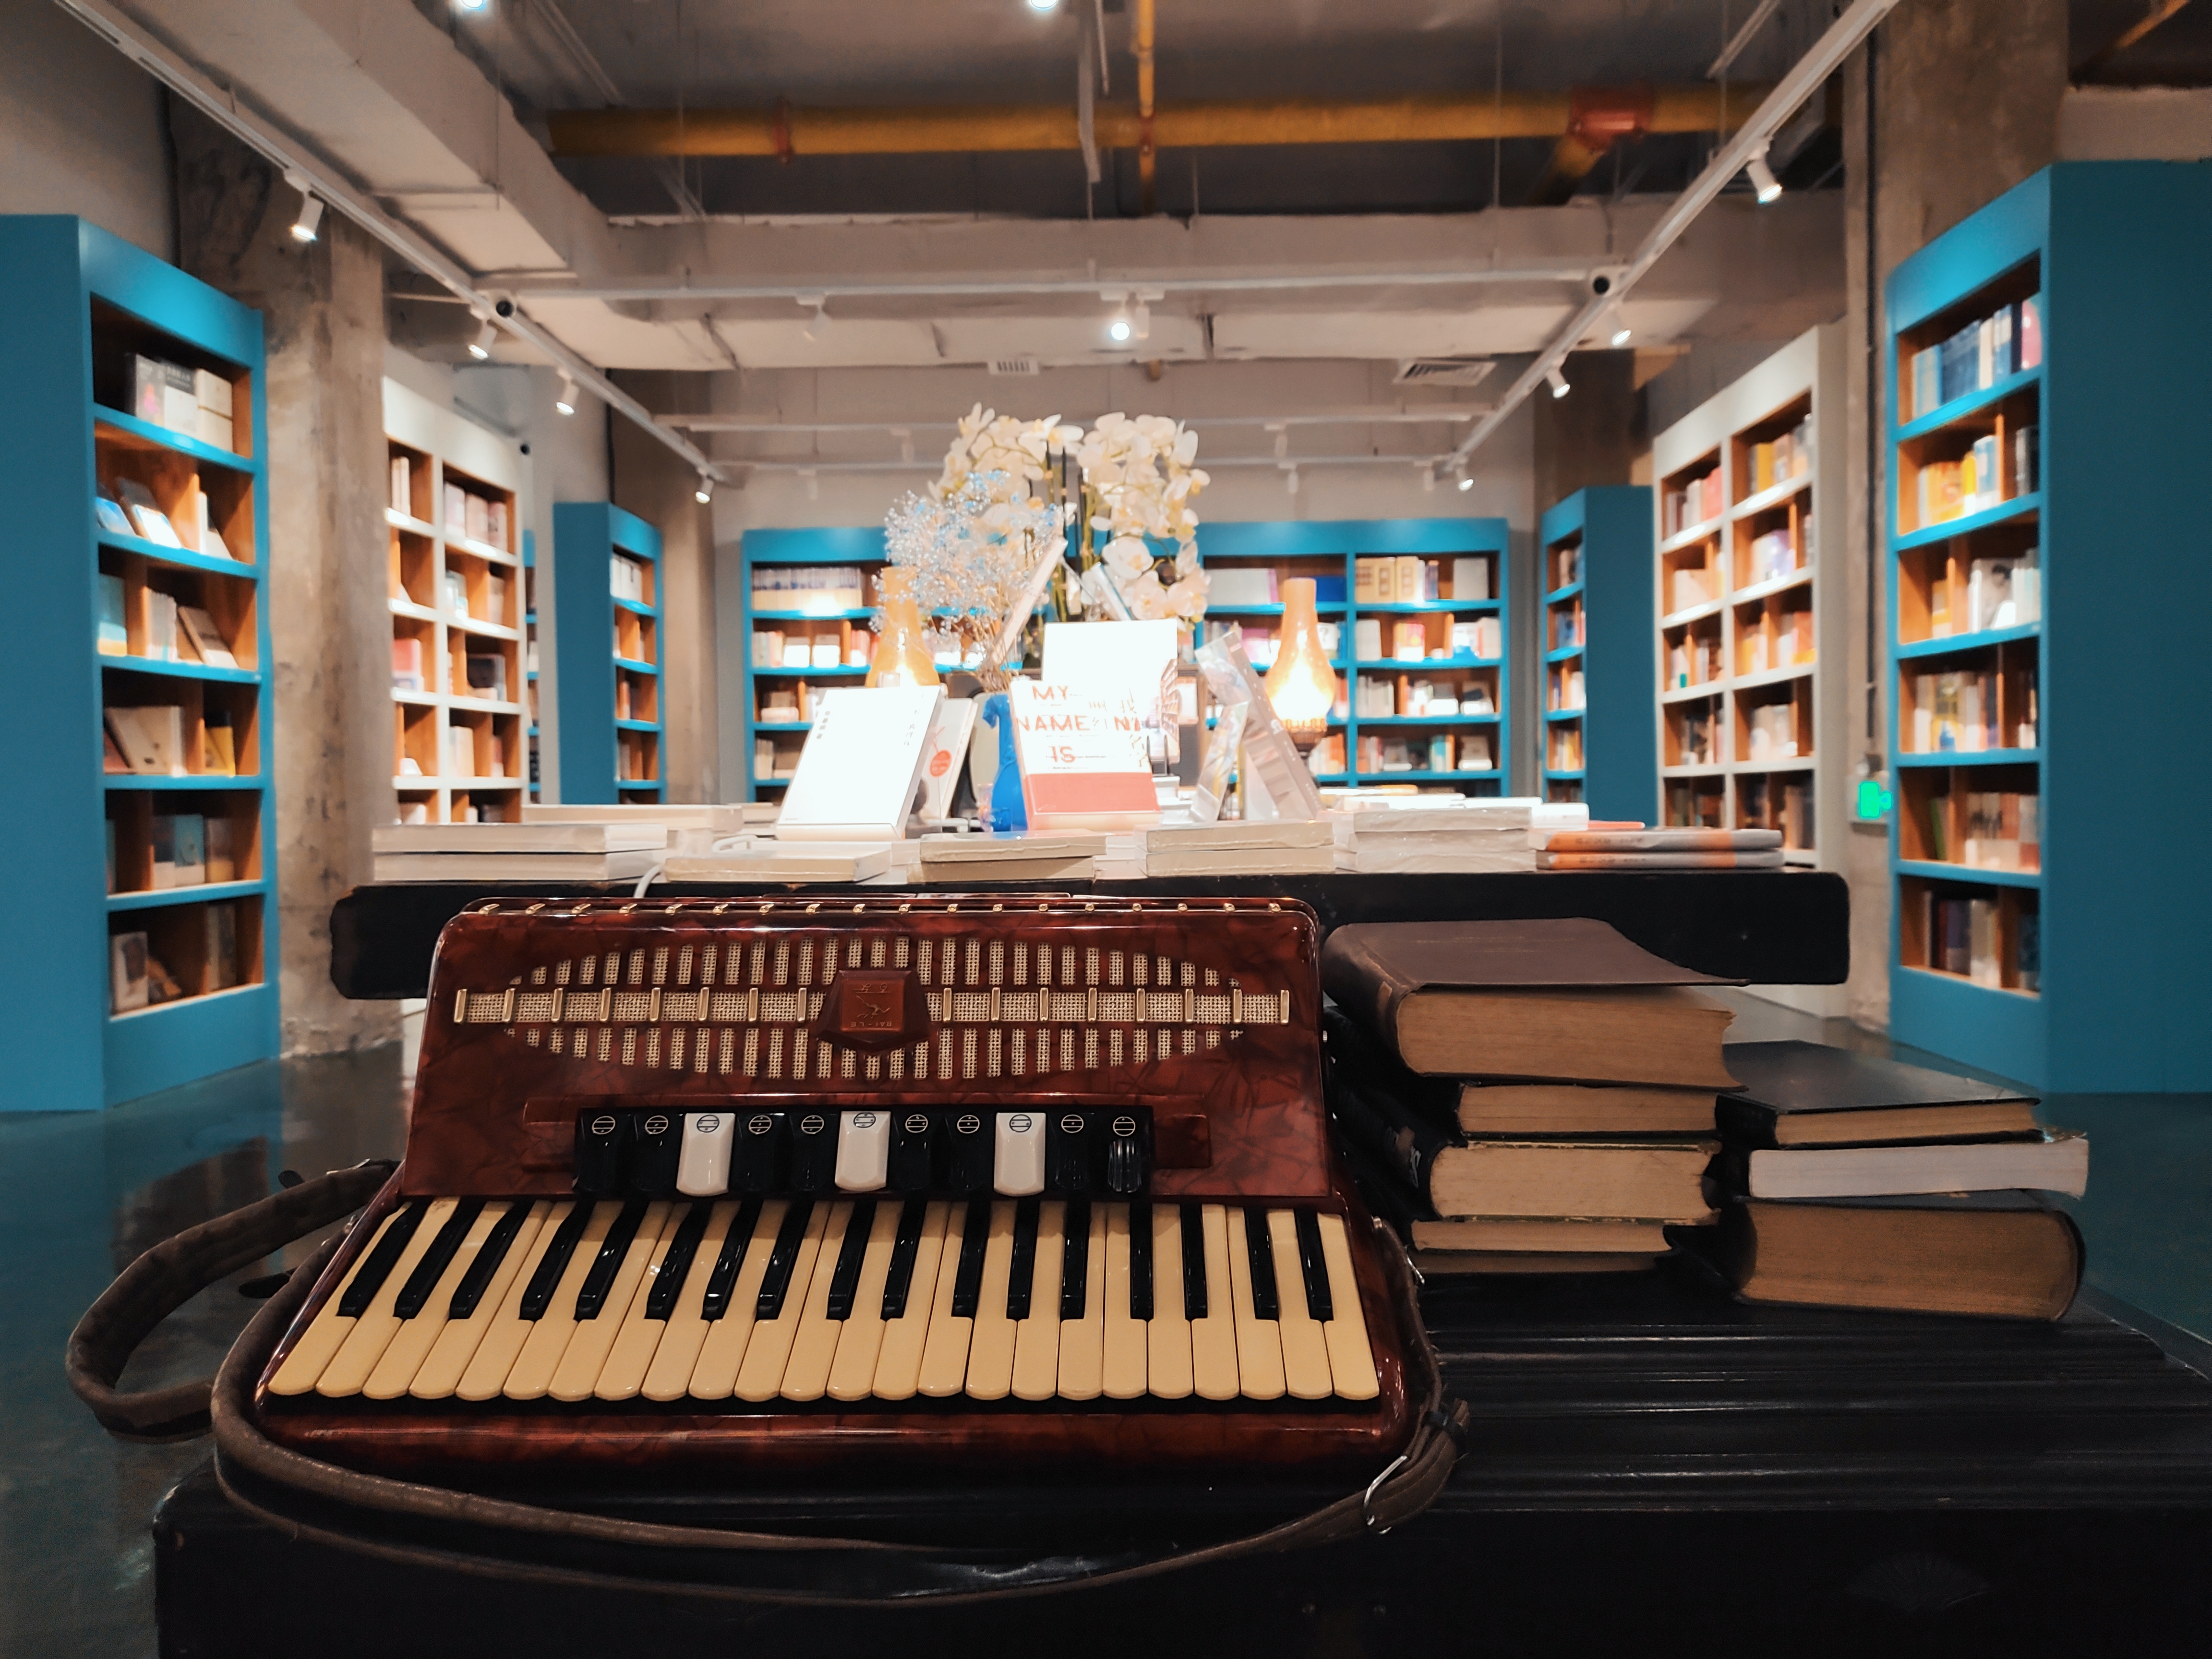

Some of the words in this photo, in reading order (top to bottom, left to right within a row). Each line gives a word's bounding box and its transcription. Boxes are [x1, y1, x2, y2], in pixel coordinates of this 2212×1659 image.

[1032, 685, 1069, 700] MY
[1016, 714, 1091, 732] NAME
[1051, 745, 1076, 763] IS
